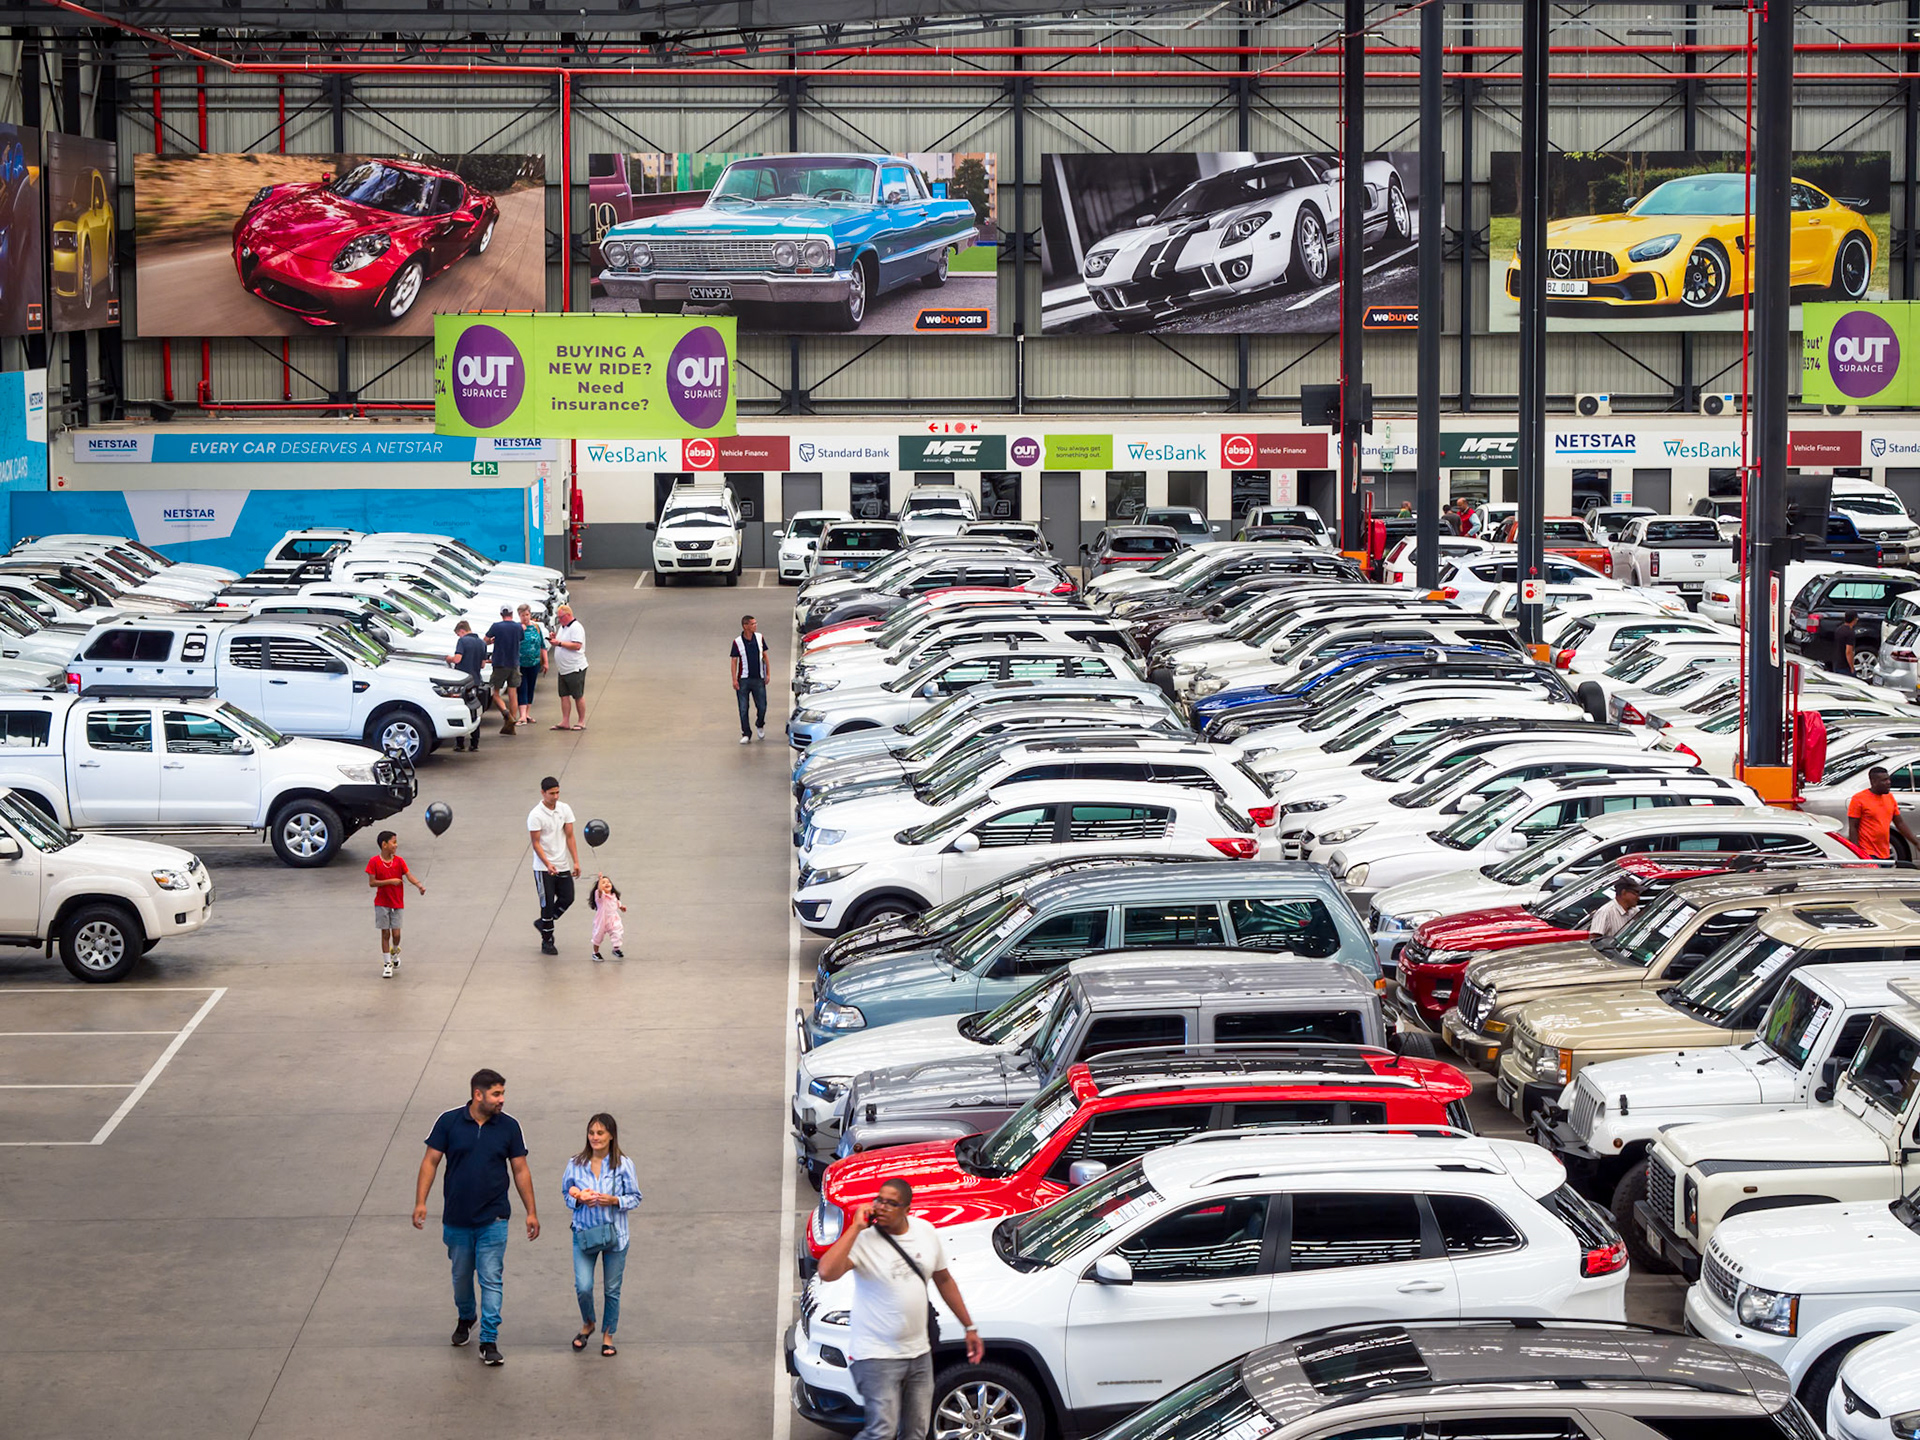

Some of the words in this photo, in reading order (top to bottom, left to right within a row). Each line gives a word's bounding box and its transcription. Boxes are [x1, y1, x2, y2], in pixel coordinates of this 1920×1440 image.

[925, 315, 982, 325] webuycars
[556, 346, 626, 358] BUYING
[632, 346, 645, 358] A
[1834, 337, 1890, 363] OUT
[457, 355, 514, 386] OUT
[549, 363, 592, 375] NEW
[600, 363, 652, 375] RIDE?
[677, 357, 725, 388] OUT
[1839, 364, 1883, 373] SURANCE
[462, 388, 507, 398] SURANCE
[578, 381, 624, 393] Need
[684, 389, 722, 399] SURANCE
[552, 397, 649, 410] insurance?
[89, 440, 137, 448] NETSTAR
[494, 438, 541, 447] NETSTAR
[1460, 437, 1518, 452] MFC
[1555, 434, 1636, 447] NETSTAR
[190, 442, 239, 454] EVERY
[242, 442, 277, 454] CAR
[280, 442, 357, 454] DESERVES
[363, 442, 375, 453] A
[376, 442, 443, 453] NETSTAR
[588, 445, 667, 462] WesBank
[689, 449, 711, 457] absa
[721, 449, 744, 457] Vehicle
[745, 449, 768, 457] Finance
[818, 448, 863, 458] Standard
[865, 448, 889, 458] Bank
[923, 441, 982, 455] MFC
[1013, 446, 1037, 455] OUT
[1127, 443, 1206, 460] WesBank
[1228, 446, 1250, 455] absa
[1663, 439, 1741, 457] WesBank
[164, 509, 215, 518] NETSTAR
